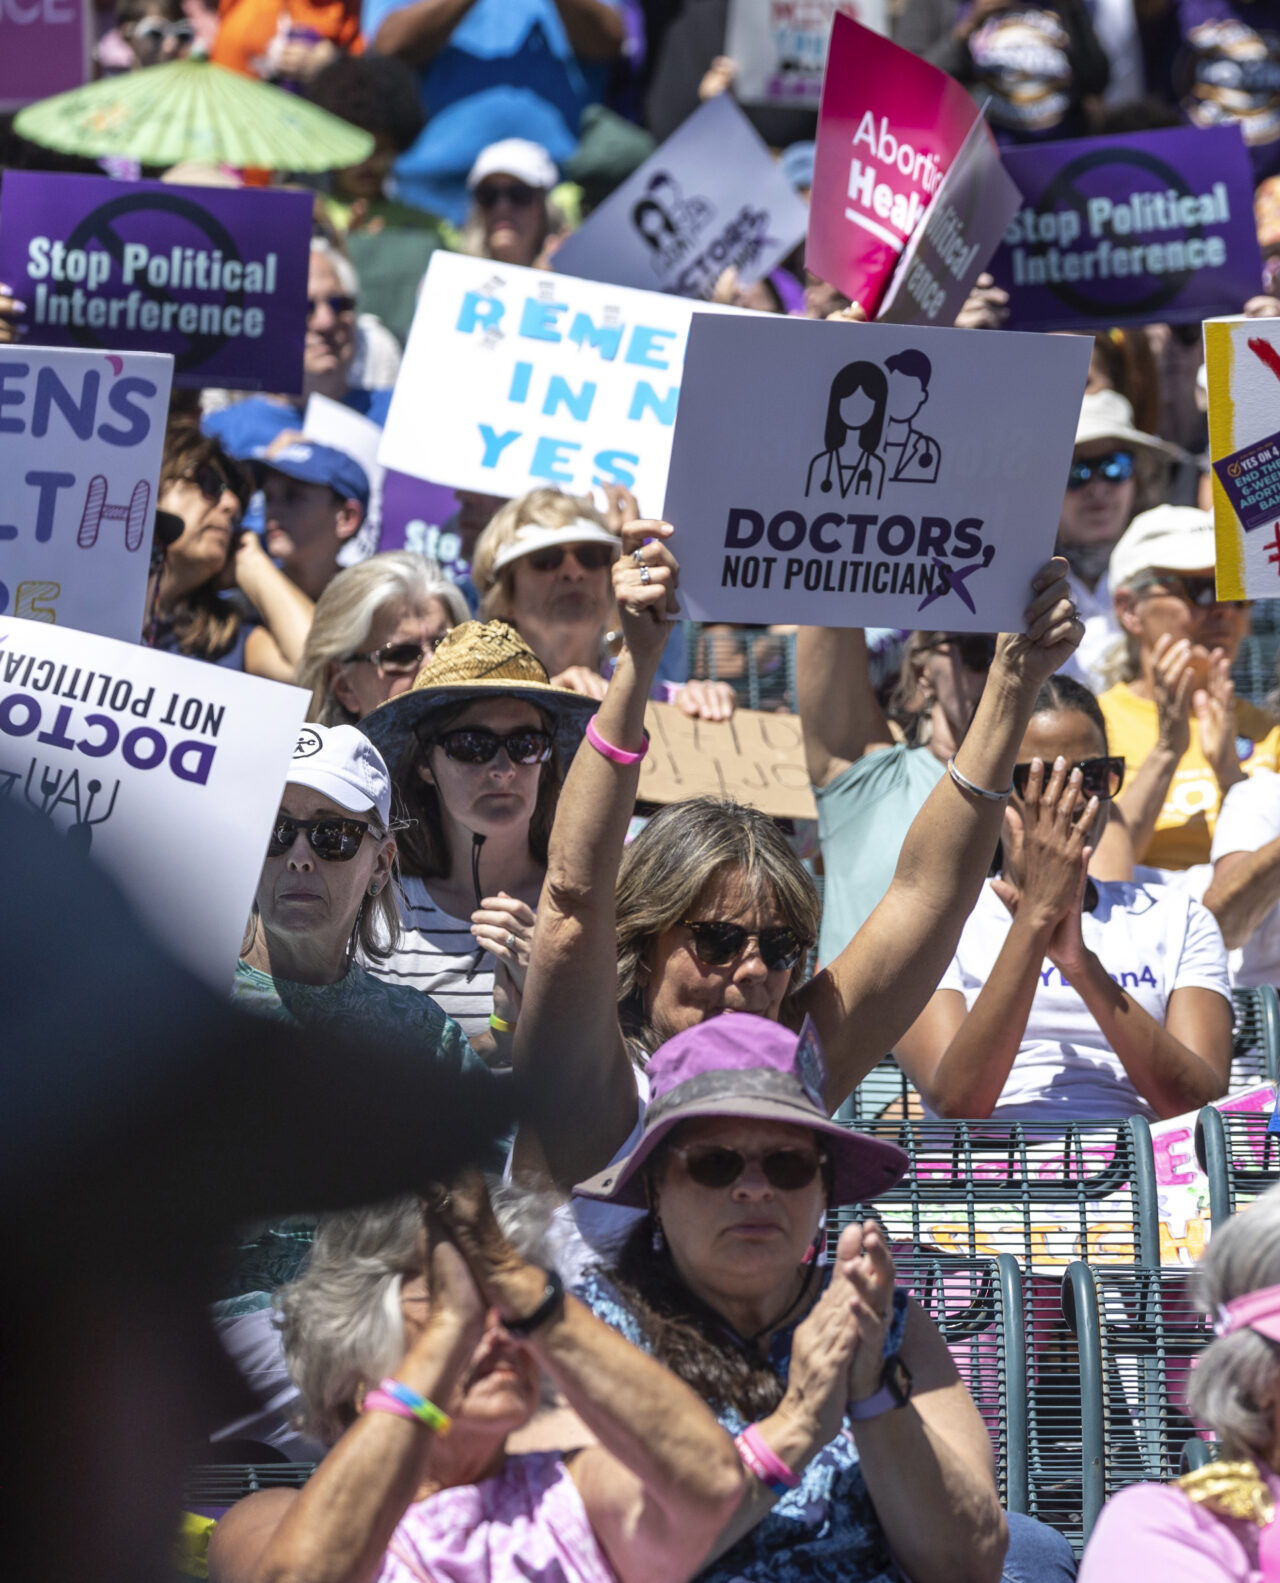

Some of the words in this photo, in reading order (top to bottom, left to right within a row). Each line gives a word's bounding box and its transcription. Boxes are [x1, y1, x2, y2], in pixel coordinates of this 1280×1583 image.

[1005, 207, 1081, 248] Stop
[1088, 181, 1231, 238] Political
[27, 236, 111, 291] Stop
[122, 243, 277, 294] Political
[1012, 235, 1227, 285] Interference
[35, 284, 265, 338] Interference
[456, 291, 690, 371] REME
[508, 361, 598, 423] IN
[477, 423, 640, 490] YES
[1234, 470, 1260, 488] END
[1240, 456, 1259, 472] YES
[1257, 450, 1273, 463] ON
[1271, 446, 1280, 457] 4
[724, 507, 996, 568] DOCTORS,
[721, 555, 779, 589] NOT
[785, 557, 954, 597] POLITICIANS
[0, 651, 156, 718] POLITICIA
[159, 692, 226, 737] NOT
